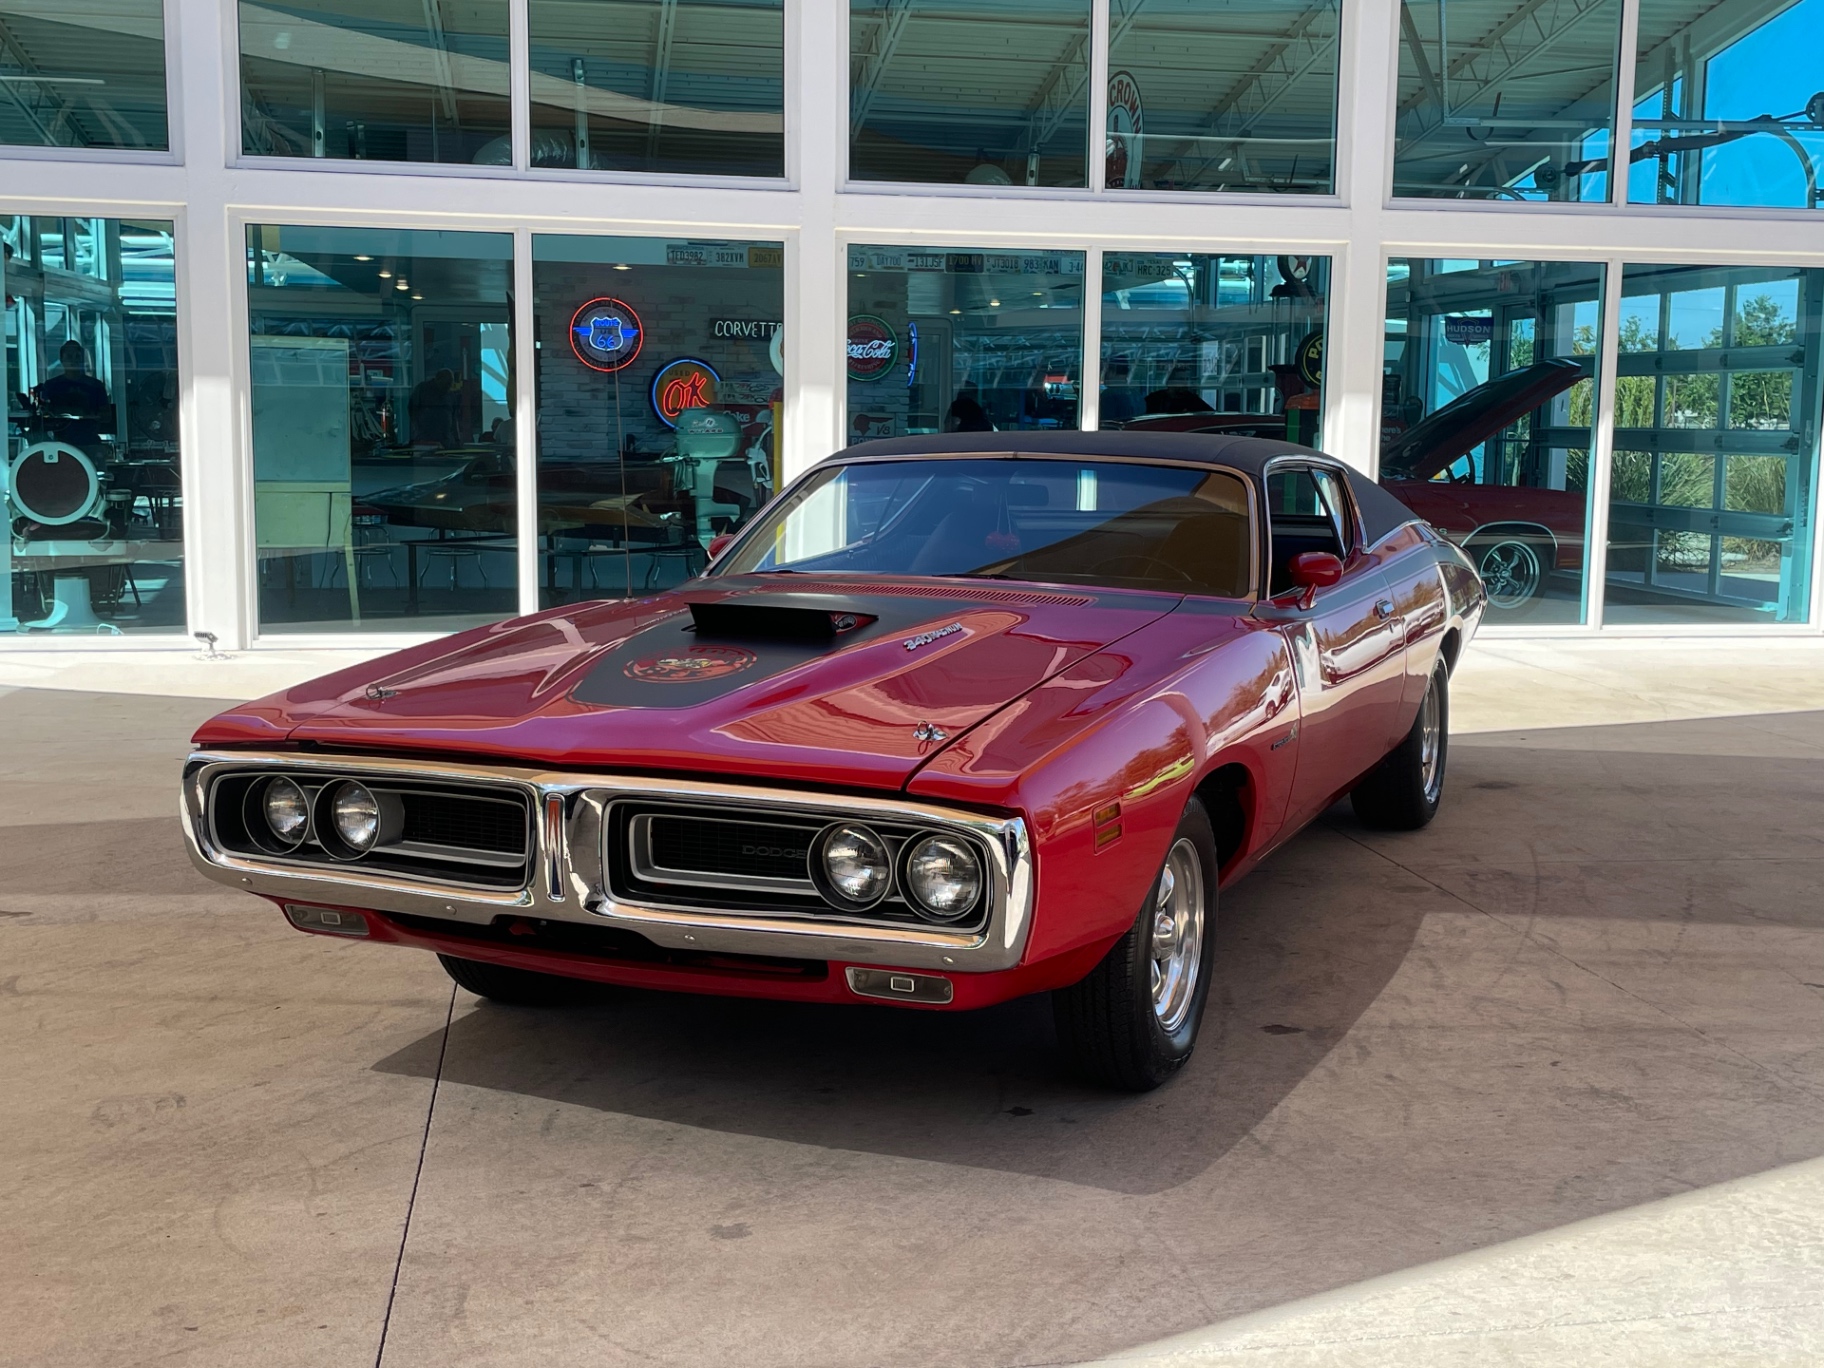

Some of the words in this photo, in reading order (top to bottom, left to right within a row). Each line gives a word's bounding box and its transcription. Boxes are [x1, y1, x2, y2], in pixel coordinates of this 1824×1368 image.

[1109, 79, 1141, 135] CROWN
[1446, 325, 1491, 334] HUDSON
[597, 335, 616, 348] 66
[663, 372, 710, 417] OK
[742, 844, 808, 859] DODGE
